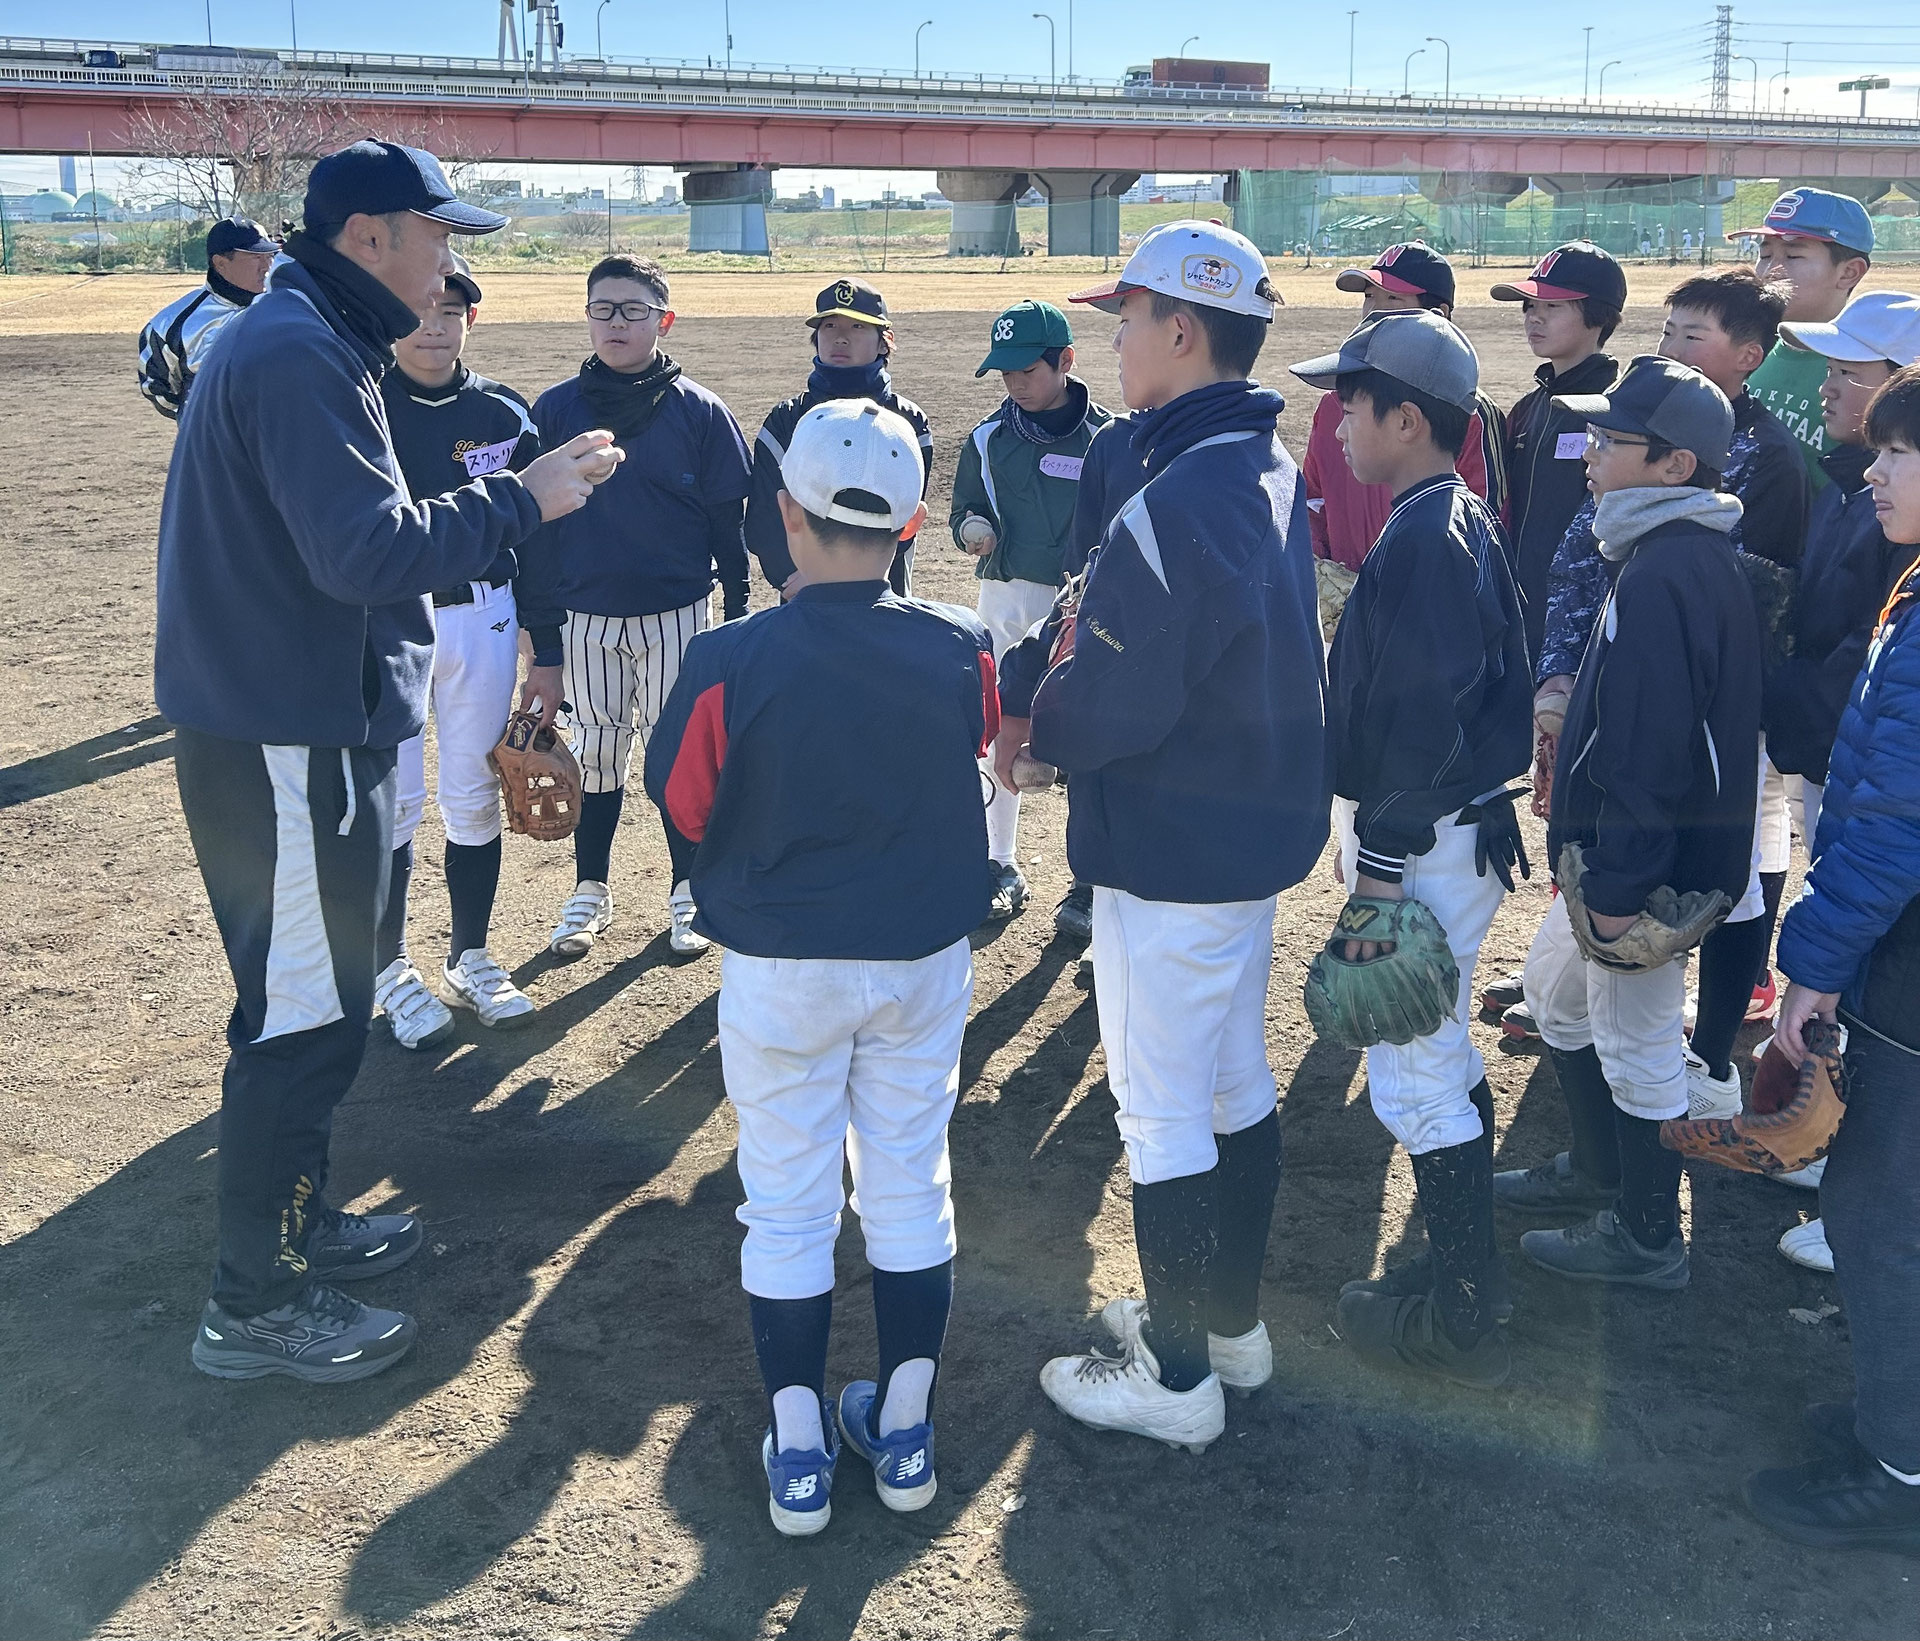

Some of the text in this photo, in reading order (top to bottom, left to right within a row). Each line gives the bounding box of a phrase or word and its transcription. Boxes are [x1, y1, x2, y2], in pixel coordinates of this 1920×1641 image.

[1376, 245, 1406, 267] N
[1750, 388, 1809, 411] OKYO
[1766, 405, 1825, 451] ATAA
